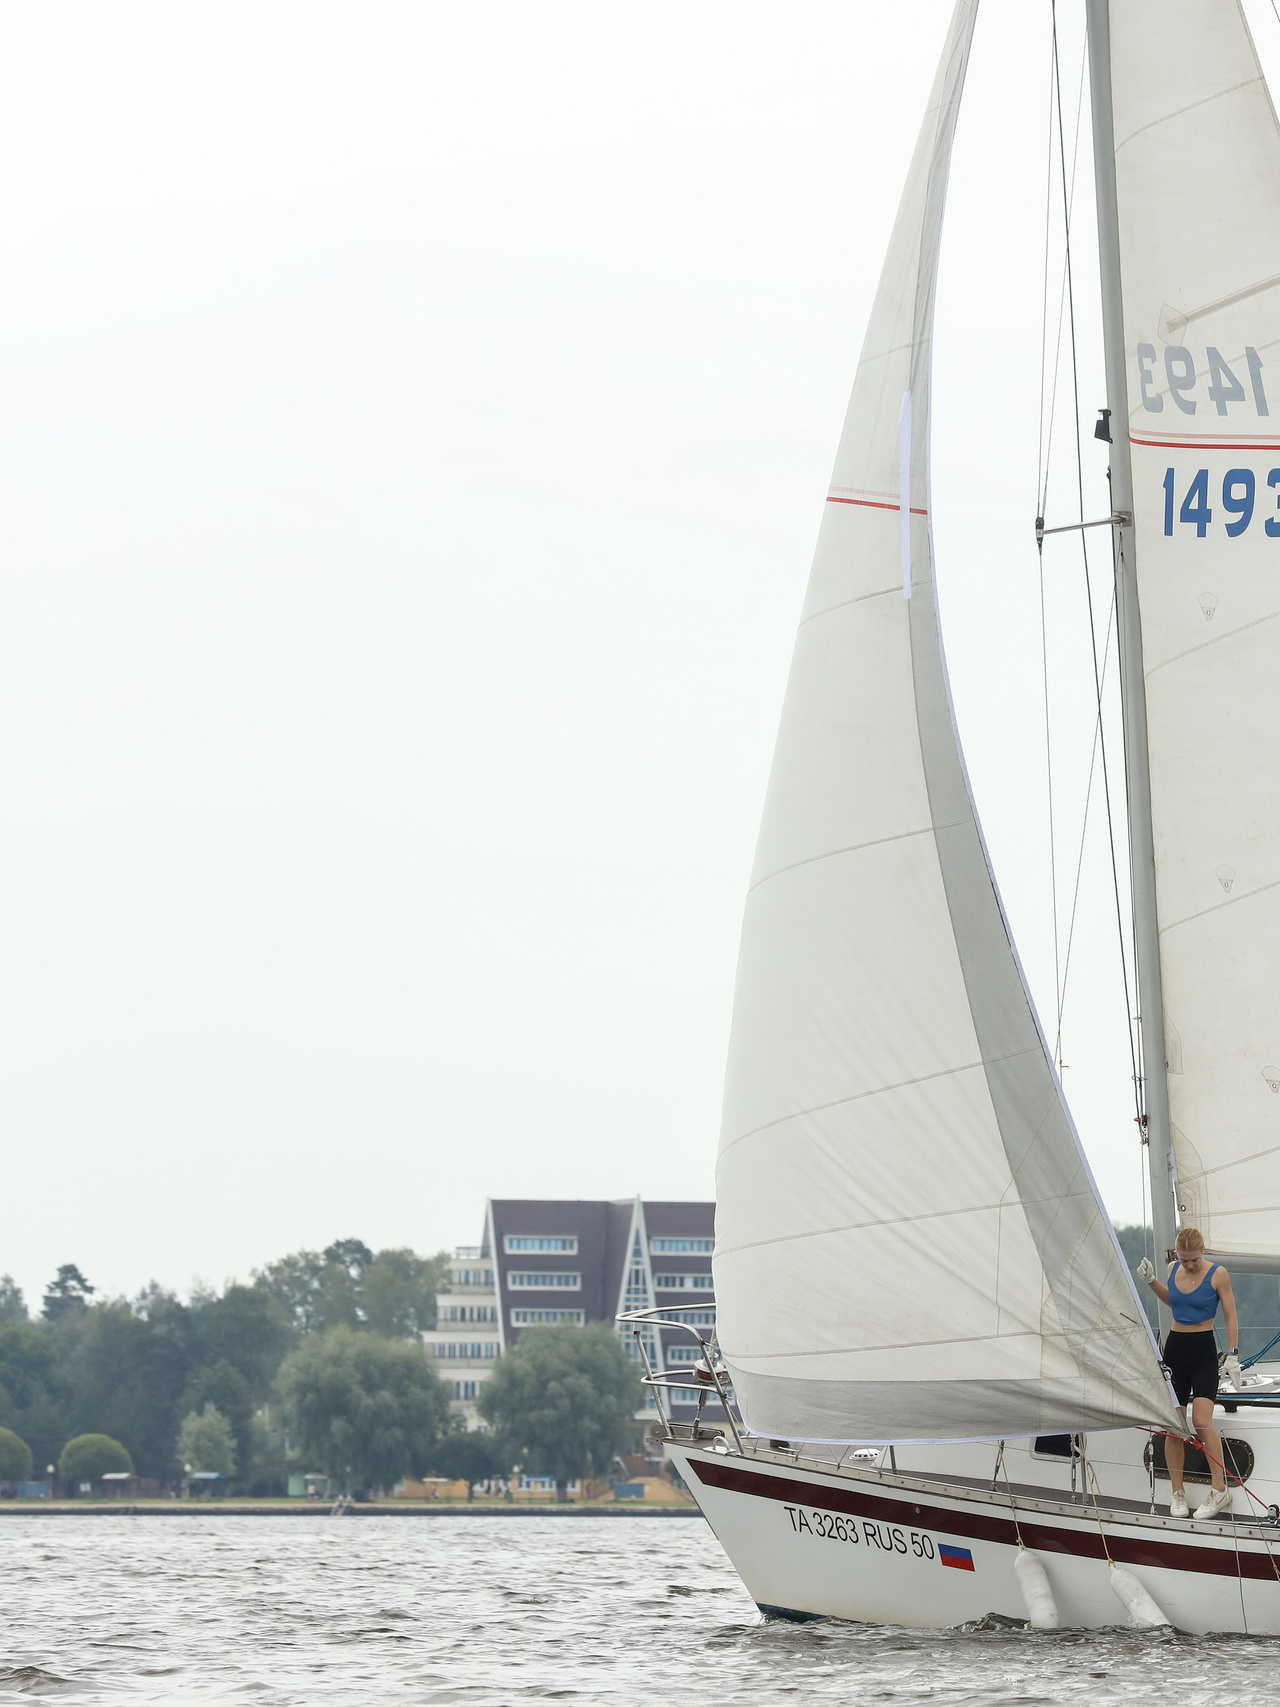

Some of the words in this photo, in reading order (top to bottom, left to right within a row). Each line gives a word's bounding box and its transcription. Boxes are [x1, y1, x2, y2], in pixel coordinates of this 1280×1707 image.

[784, 1506, 813, 1535] TA
[812, 1512, 859, 1544] 3263
[862, 1521, 908, 1554] RUS
[910, 1532, 935, 1560] 50
